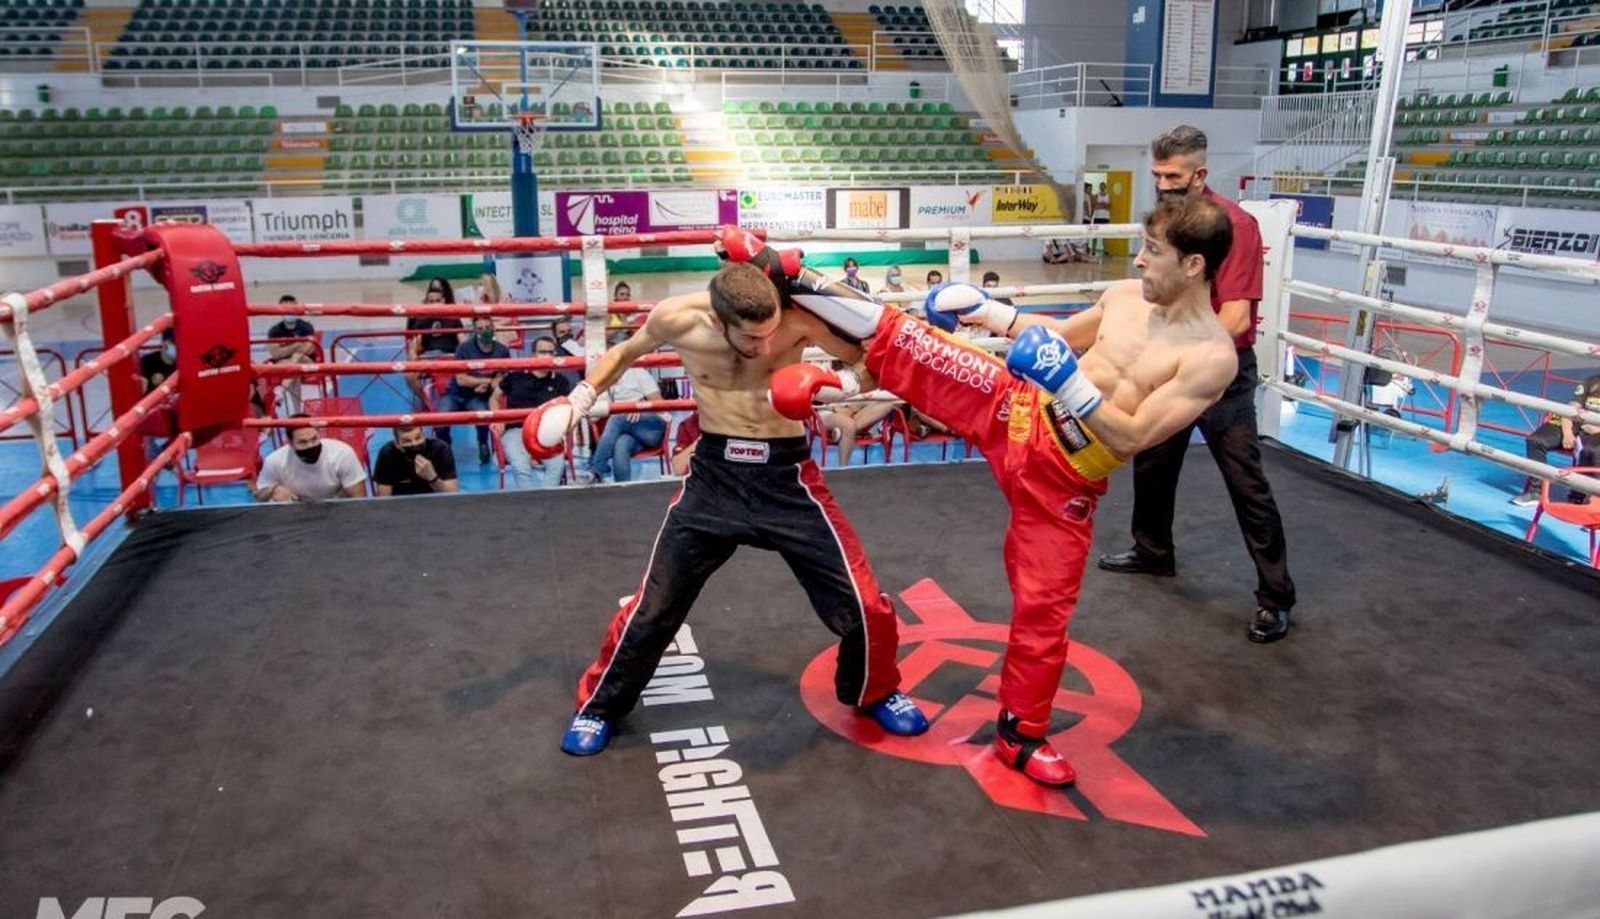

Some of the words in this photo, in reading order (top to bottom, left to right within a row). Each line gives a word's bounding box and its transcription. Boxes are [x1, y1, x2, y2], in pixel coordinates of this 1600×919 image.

[475, 205, 512, 218] INTECT
[850, 193, 887, 218] mabel
[917, 205, 966, 215] PREMIUM
[996, 199, 1038, 212] InterWay
[261, 209, 348, 231] Triumph
[594, 213, 639, 226] hospital
[1511, 228, 1591, 252] BIERZO
[901, 320, 1001, 379] BARYMONT
[894, 333, 995, 394] &ASOCIADOS
[650, 725, 796, 918] FIGHTER
[1190, 871, 1325, 909] MAMBA
